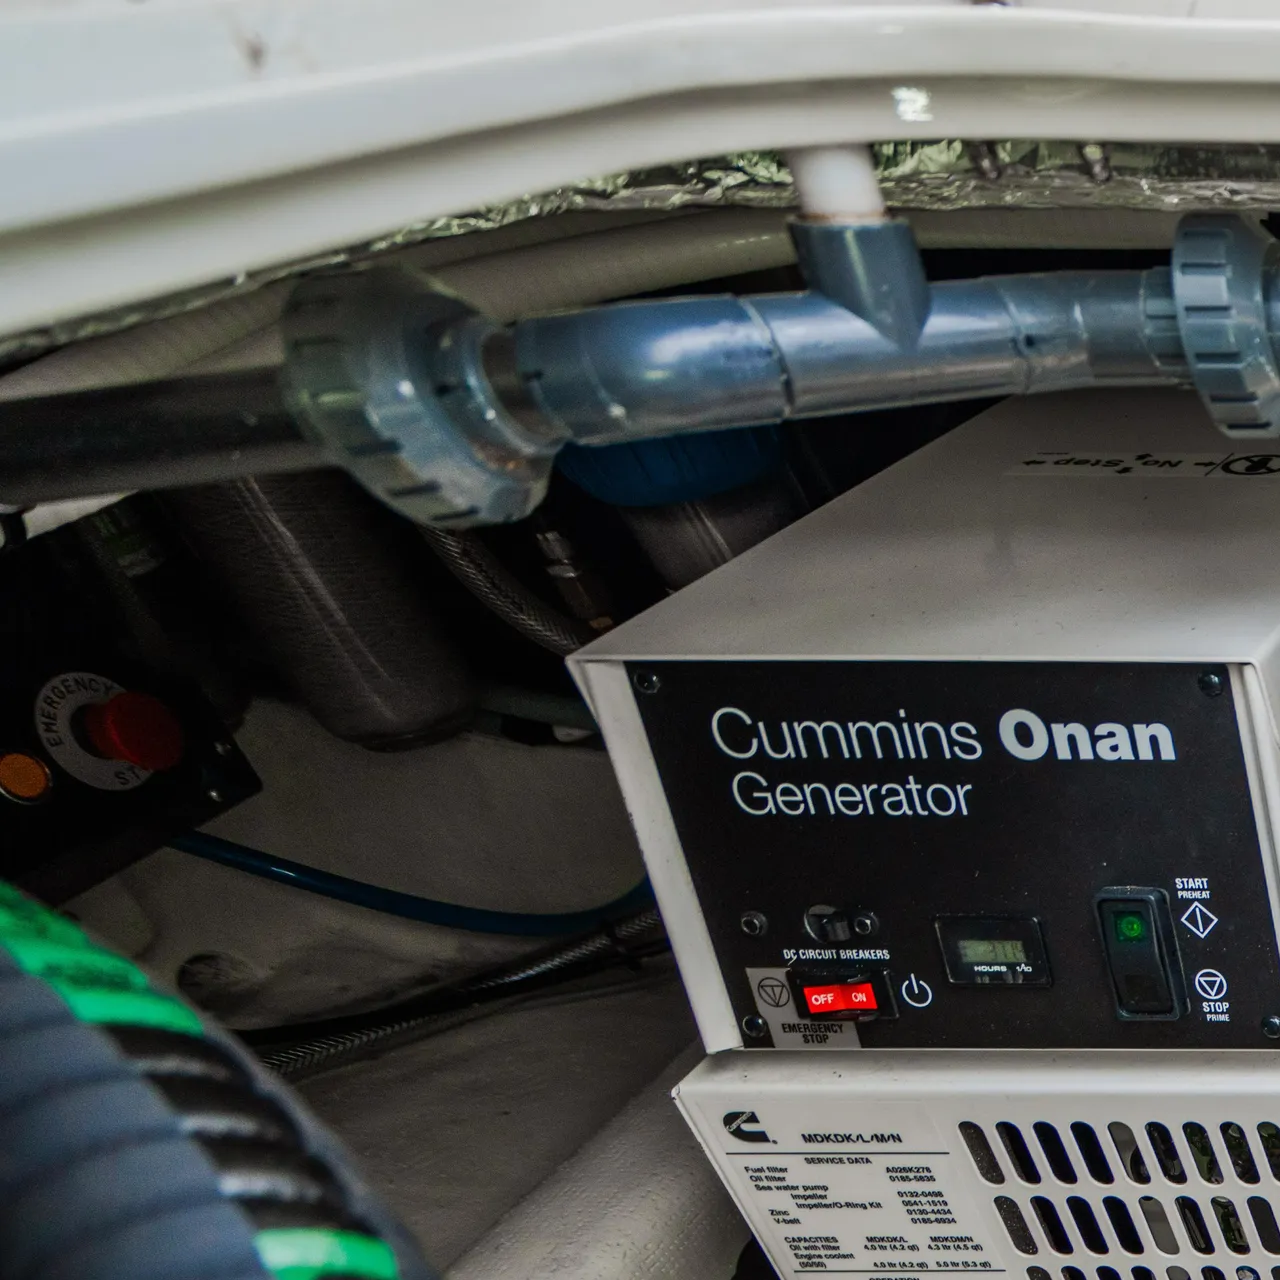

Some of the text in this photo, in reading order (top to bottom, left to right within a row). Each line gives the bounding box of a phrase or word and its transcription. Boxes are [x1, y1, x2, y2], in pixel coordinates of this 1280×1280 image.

[1053, 458, 1183, 468] No Step
[41, 676, 114, 748] EMERGENCY
[711, 707, 1177, 761] Cummins Onan
[732, 772, 972, 816] Generator
[1175, 878, 1208, 889] START
[1178, 891, 1210, 899] PREHEAT
[783, 950, 890, 959] DC CIRCUIT BREAKERS
[812, 992, 866, 1005] OFF ON
[1202, 1002, 1229, 1012] STOP
[782, 1024, 844, 1033] EMERGENCY
[803, 1034, 829, 1043] STOP
[801, 1133, 902, 1143] MDKDK/L/M/N
[802, 1185, 829, 1193] pump
[791, 1193, 827, 1201] Impeller
[796, 1202, 867, 1210] Impeller/O-Ring
[799, 1261, 827, 1269] (50/50)
